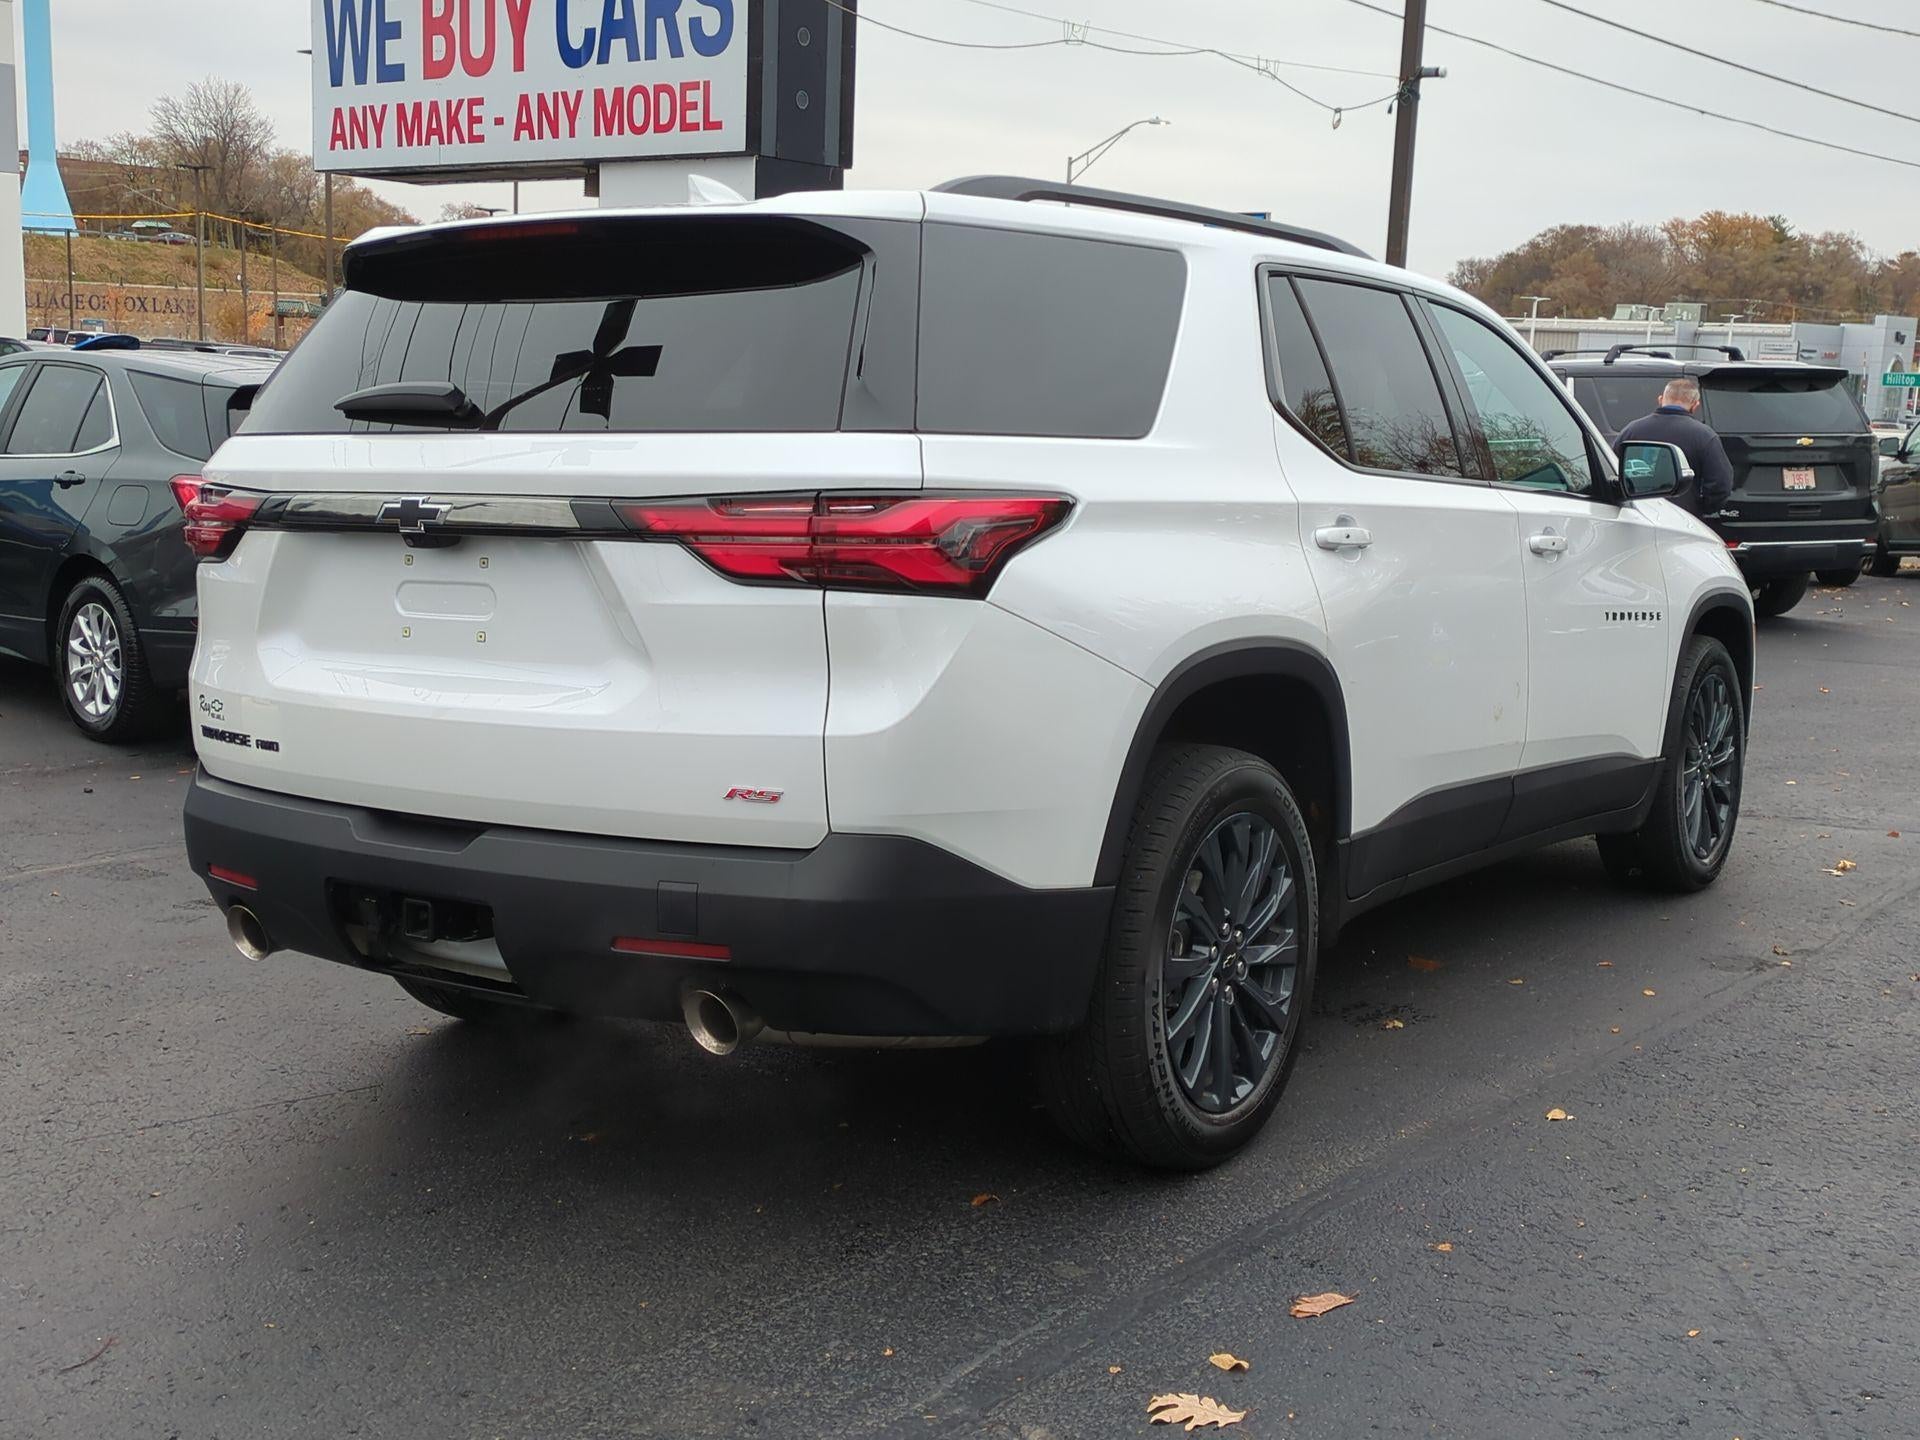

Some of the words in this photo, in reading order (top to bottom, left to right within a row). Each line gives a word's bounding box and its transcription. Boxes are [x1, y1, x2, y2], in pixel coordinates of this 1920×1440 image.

[323, 0, 405, 88] WE
[421, 0, 533, 80] BUY
[555, 0, 734, 69] CARS
[329, 103, 388, 151] ANY
[395, 97, 486, 148] MAKE
[513, 89, 584, 141] ANY
[593, 80, 723, 137] MODEL
[1886, 374, 1916, 386] Hilltop
[1605, 611, 1662, 621] TRAVERSE
[722, 787, 784, 804] RS
